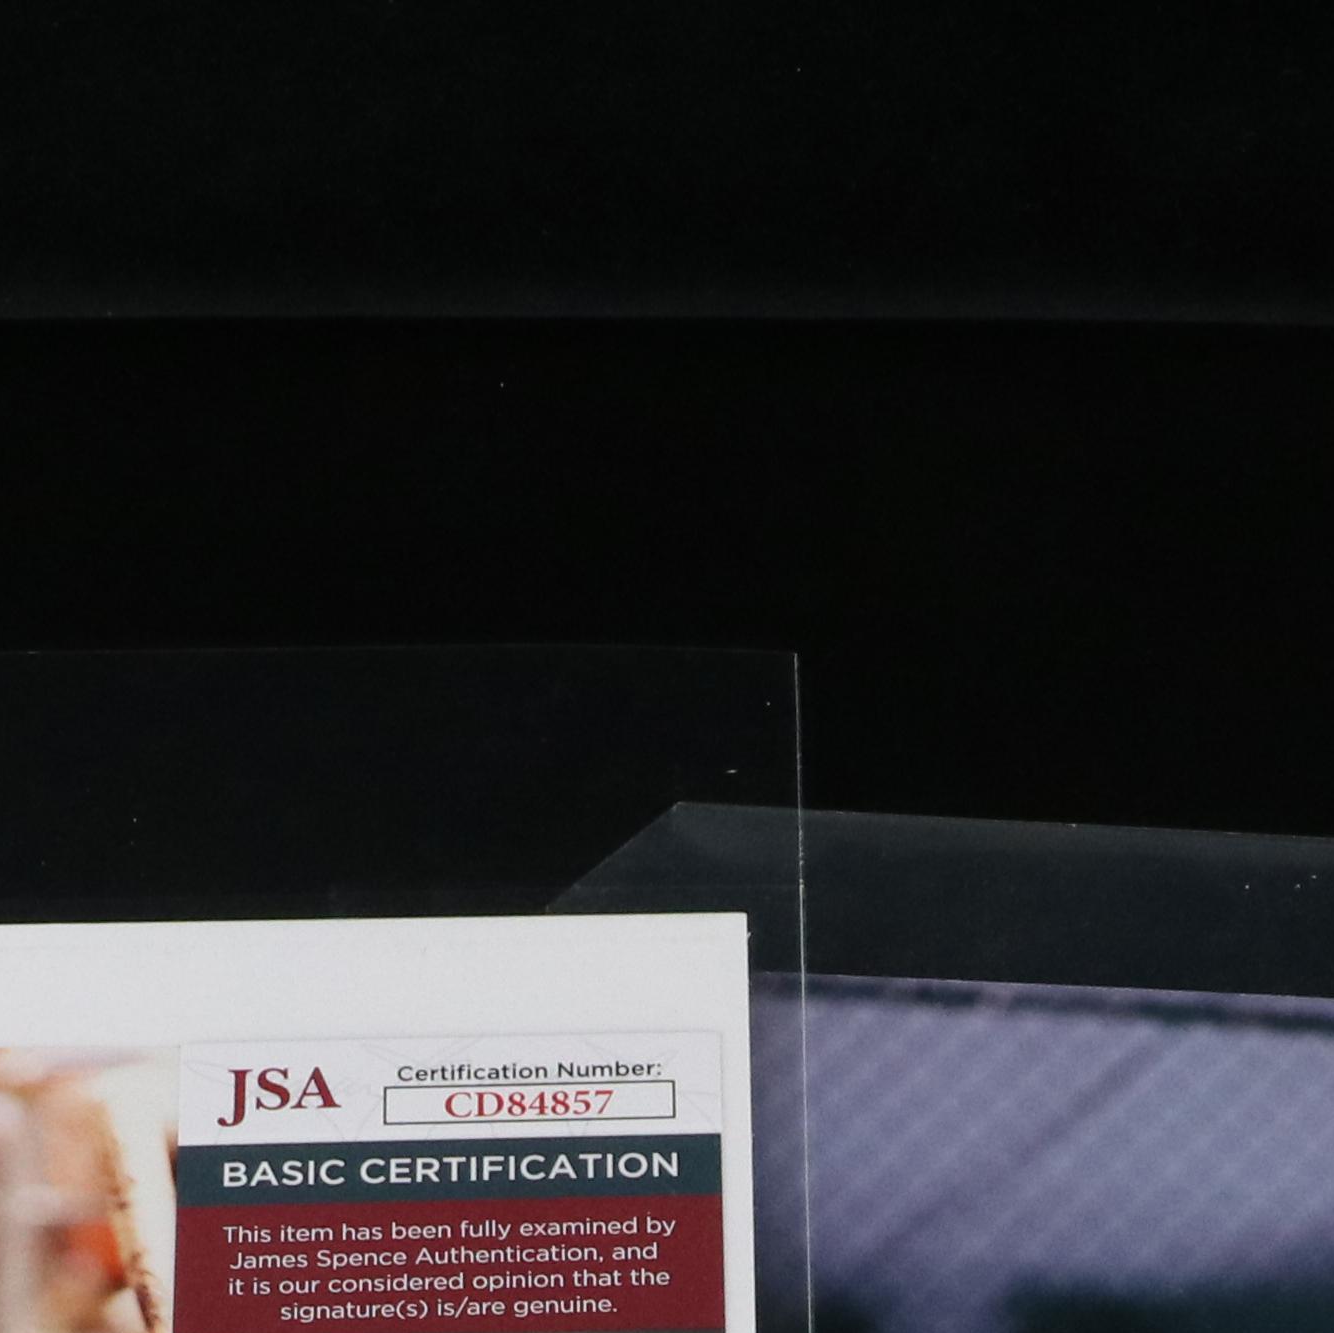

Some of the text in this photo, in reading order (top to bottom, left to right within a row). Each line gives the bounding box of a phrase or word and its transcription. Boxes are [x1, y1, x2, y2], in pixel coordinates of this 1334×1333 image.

[397, 1060, 661, 1082] Certification Number:
[217, 1066, 342, 1128] JSA
[444, 1090, 614, 1118] CD84857
[223, 1152, 679, 1188] BASIC CERTIFICATION
[222, 1216, 676, 1244] This item has been fully examined by
[229, 1241, 658, 1271] James Spence Authentication, and
[229, 1267, 671, 1296] it is our considered opinion that the
[280, 1295, 618, 1324] signature(s) is/are genuine.
